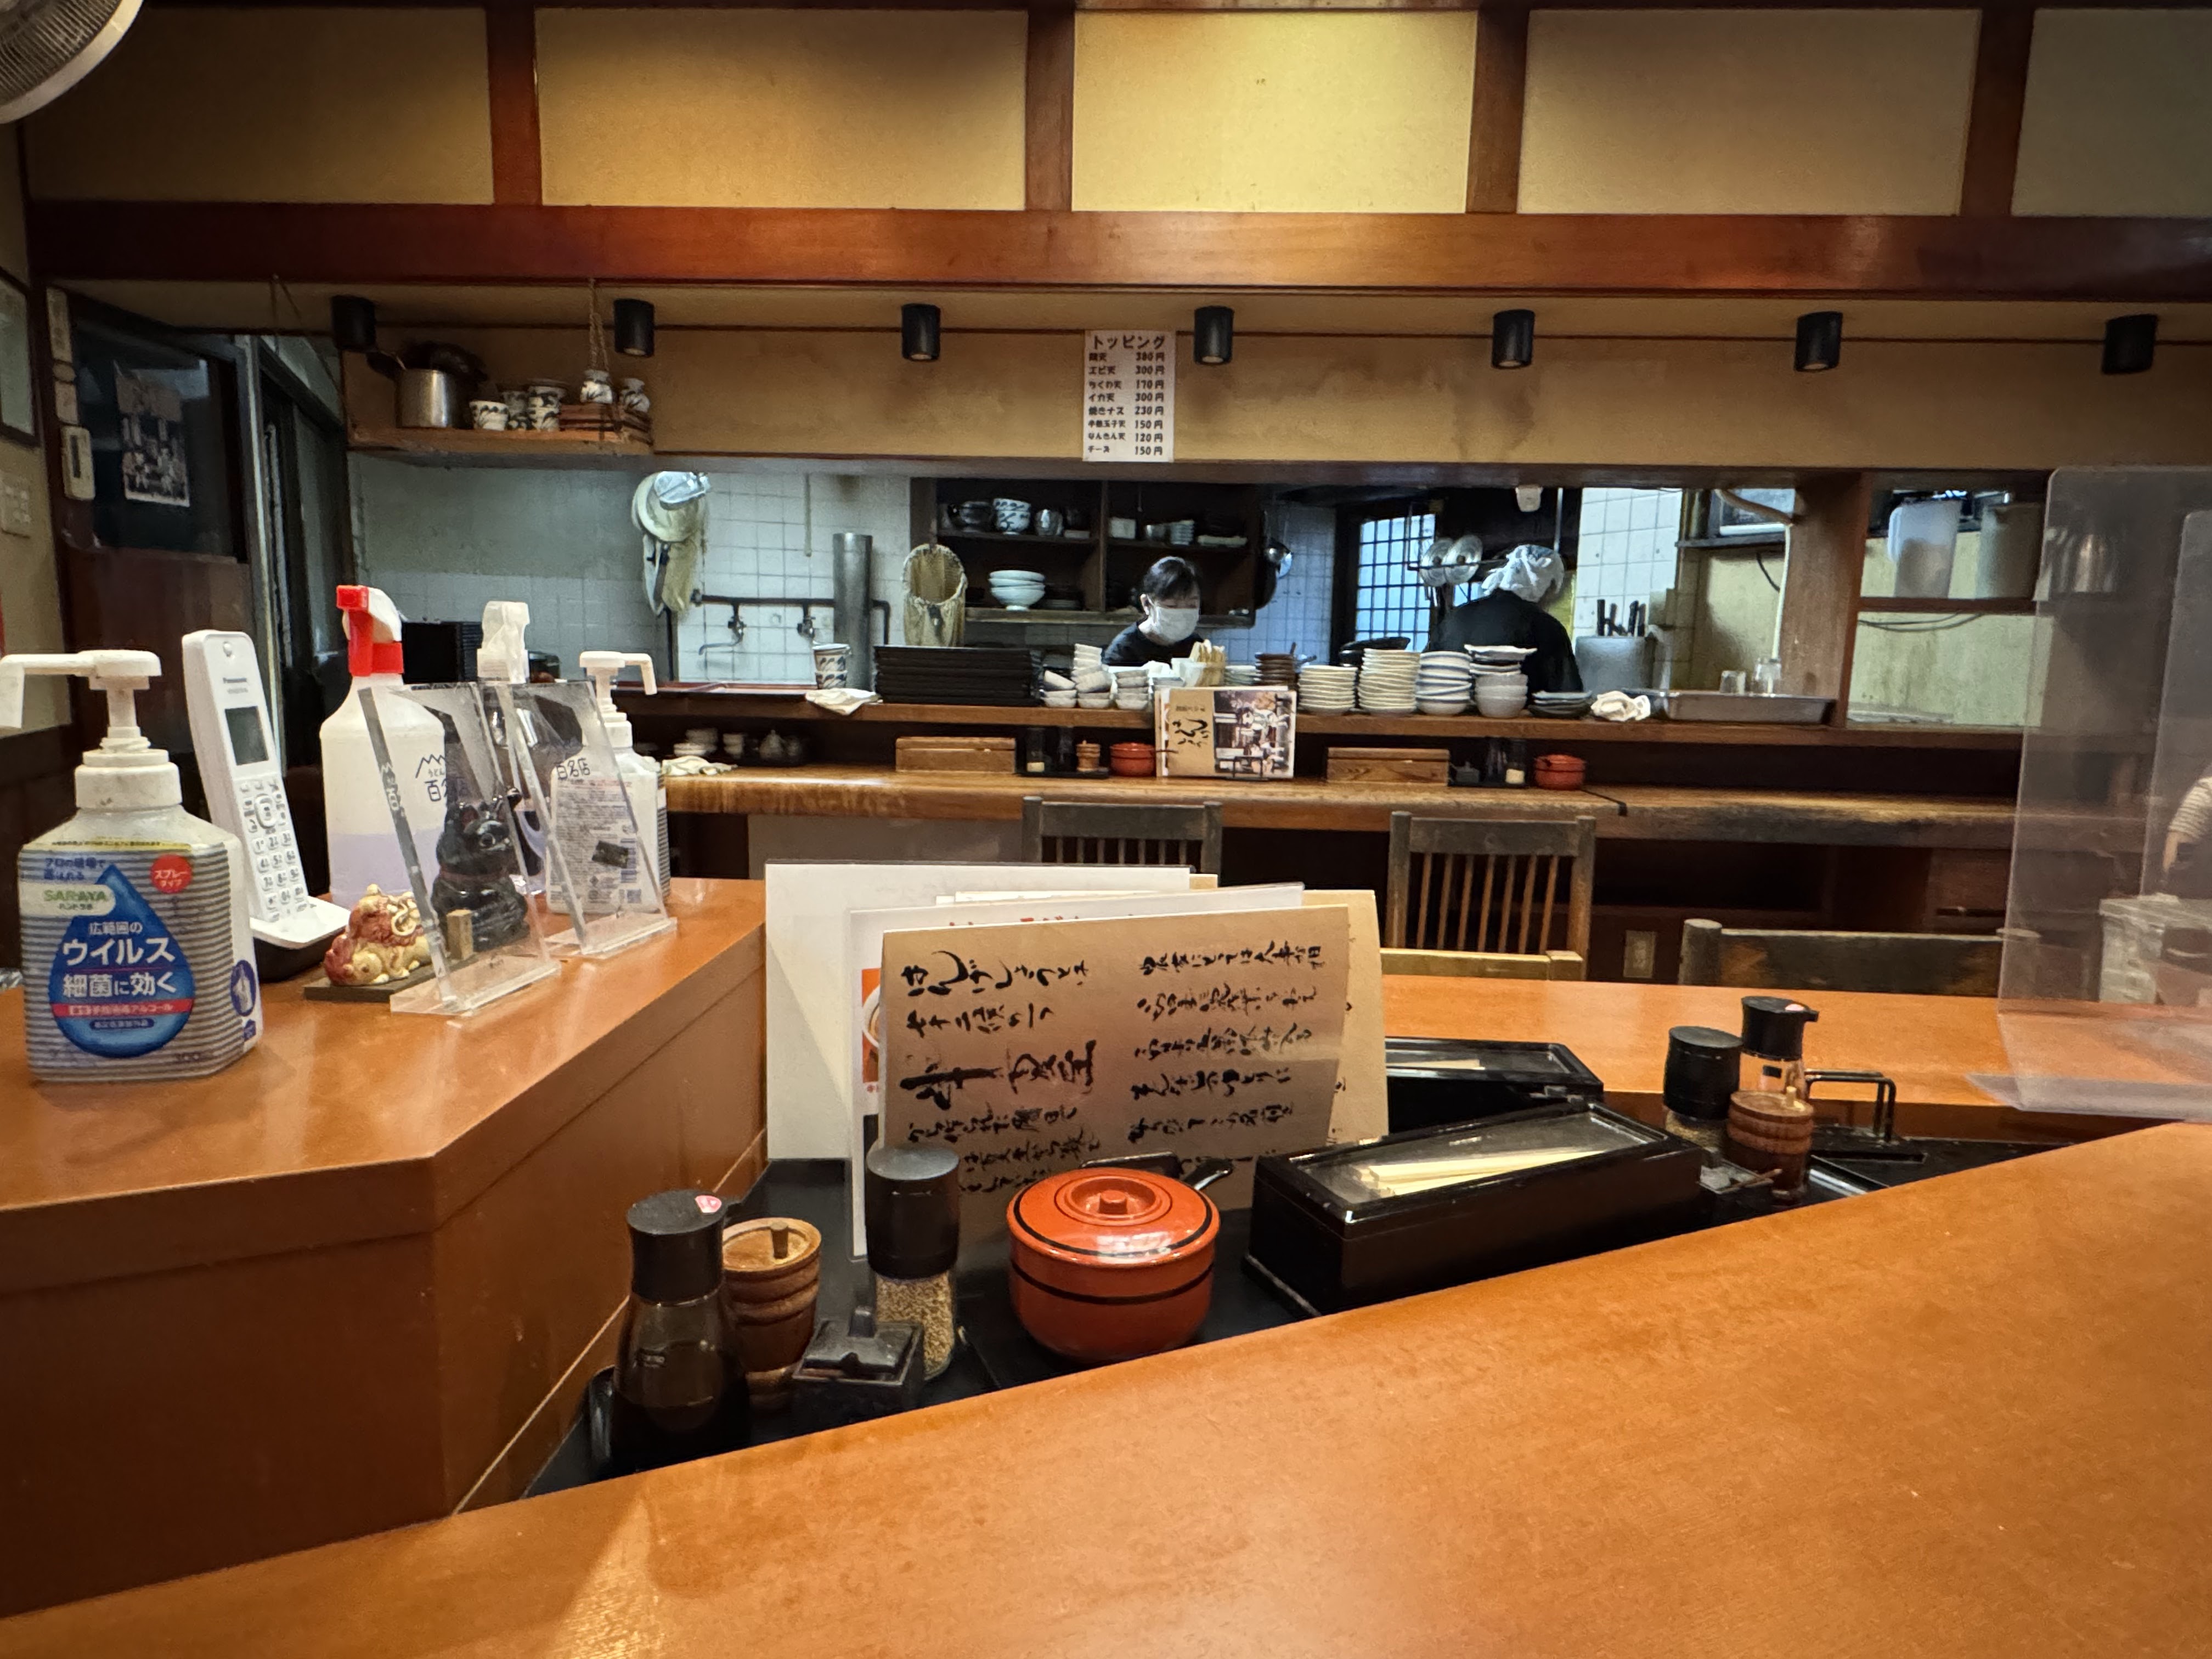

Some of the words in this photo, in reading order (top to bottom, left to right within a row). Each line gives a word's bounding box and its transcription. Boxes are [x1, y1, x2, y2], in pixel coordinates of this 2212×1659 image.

[1094, 335, 1165, 349] トッピング
[1089, 365, 1115, 375] エビ天
[1136, 365, 1164, 375] 300円
[1136, 380, 1164, 389] 170円
[1088, 393, 1114, 402] イカ天
[1135, 392, 1164, 402] 300円
[1135, 406, 1164, 415] 230円
[1135, 420, 1163, 429] 150円
[1135, 445, 1163, 455] 150円
[154, 869, 188, 879] スプレー
[44, 890, 106, 901] SARAYA
[89, 921, 143, 935] 広範囲の
[63, 938, 176, 966] ウイルス
[63, 972, 177, 998] 細菌に効く
